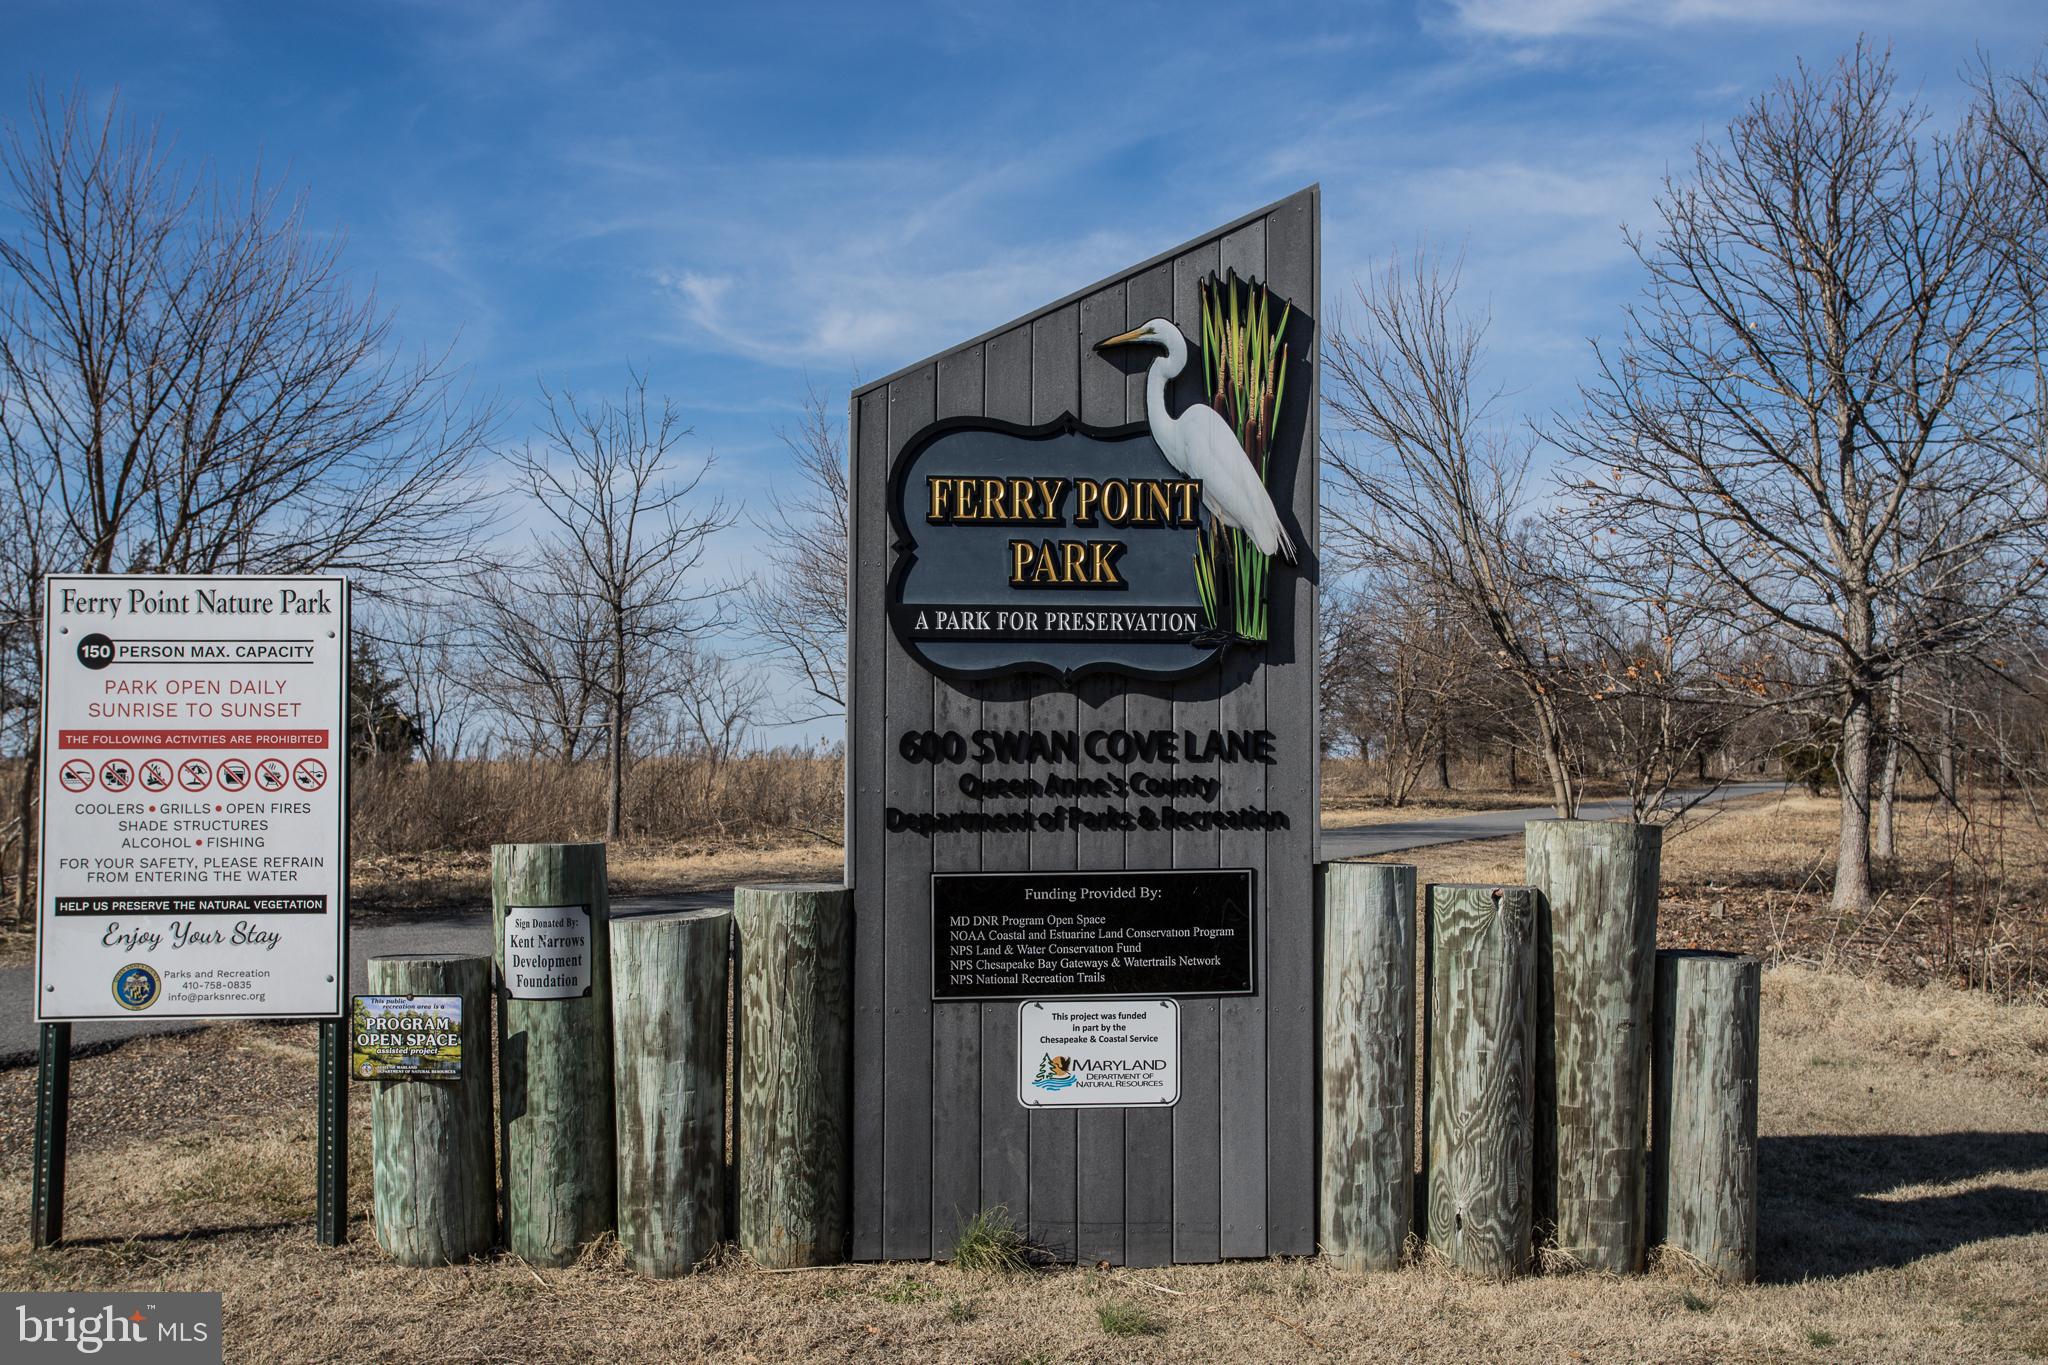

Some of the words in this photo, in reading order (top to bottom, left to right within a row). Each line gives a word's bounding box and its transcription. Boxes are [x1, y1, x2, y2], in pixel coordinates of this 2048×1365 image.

[927, 476, 1071, 527] FERRY
[1074, 479, 1202, 529] POINT
[1009, 539, 1128, 590] PARK
[60, 588, 122, 618] Ferry
[128, 588, 190, 614] Point
[195, 588, 273, 614] Nature
[279, 588, 332, 614] Park
[914, 611, 929, 630] A
[935, 611, 991, 631] PARK
[996, 611, 1038, 631] FOR
[1044, 612, 1197, 632] PRESERVATION
[81, 645, 111, 658] 150
[119, 646, 185, 658] PERSON
[191, 646, 230, 658] MAX.
[236, 646, 314, 658] CAPACITY
[105, 681, 157, 695] PARK
[165, 680, 221, 695] OPEN
[229, 680, 287, 695] DAILY
[88, 703, 179, 718] SUNRISE
[186, 703, 214, 718] TO
[221, 702, 302, 718] SUNSET
[66, 735, 88, 744] THE
[92, 735, 162, 744] FOLLOWING
[165, 735, 226, 744] ACTIVITIES
[229, 735, 252, 744] ARE
[256, 735, 322, 744] PROHIBITED
[900, 730, 968, 765] 600
[971, 730, 1079, 765] SWAN
[1084, 730, 1180, 765] COVE
[1184, 730, 1277, 765] LANE
[959, 772, 1043, 800] Queen
[1043, 772, 1129, 799] Anne's
[1129, 772, 1221, 803] County
[75, 804, 145, 815] COOLERS
[160, 803, 211, 815] GRILLS
[226, 803, 265, 814] OPEN
[270, 803, 311, 814] FIRES
[1038, 805, 1068, 831] of
[1068, 805, 1137, 831] Parks
[1137, 806, 1161, 831] &
[1161, 805, 1290, 831] Recreation
[118, 821, 168, 832] SHADE
[173, 820, 269, 832] STRUCTURES
[122, 838, 192, 849] ALCOHOL
[207, 838, 265, 848] FISHING
[60, 858, 89, 869] FOR
[94, 858, 134, 869] YOUR
[140, 858, 199, 869] SAFETY,
[204, 857, 257, 868] PLEASE
[263, 857, 324, 868] REFRAIN
[87, 872, 129, 883] FROM
[135, 871, 209, 882] ENTERING
[214, 871, 243, 882] THE
[247, 870, 298, 882] WATER
[1024, 888, 1077, 902] Funding
[1080, 887, 1137, 900] Provided
[1140, 887, 1162, 900] By:
[60, 902, 90, 911] HELP
[93, 902, 109, 911] US
[112, 901, 170, 911] PRESERVE
[173, 901, 196, 910] THE
[199, 900, 251, 910] NATURAL
[254, 899, 323, 910] VEGETATION
[515, 919, 530, 929] Sign
[533, 918, 563, 928] Donated
[567, 918, 578, 929] By:
[950, 916, 970, 926] MD
[973, 916, 999, 926] DNR
[1002, 916, 1044, 928] Program
[1047, 915, 1074, 927] Open
[1077, 915, 1106, 926] Space
[101, 922, 163, 951] Enjoy
[169, 922, 225, 949] Your
[231, 921, 282, 950] Stay
[950, 931, 986, 941] NOAA
[989, 930, 1026, 940] Coastal
[1029, 930, 1047, 939] and
[1050, 929, 1096, 939] Estuarine
[1099, 928, 1123, 938] Land
[1126, 928, 1190, 938] Conservation
[1193, 927, 1234, 939] Program
[510, 935, 534, 948] Kent
[538, 935, 584, 948] Narrows
[950, 946, 973, 955] NPS
[976, 945, 1001, 955] Land
[1004, 945, 1014, 955] &
[1017, 944, 1046, 955] Water
[1049, 943, 1113, 954] Conservation
[1116, 942, 1142, 952] Fund
[513, 954, 582, 971] Development
[950, 960, 973, 970] NPS
[976, 959, 1035, 972] Chesapeake
[1038, 959, 1057, 971] Bay
[1061, 958, 1108, 970] Gateways
[1111, 957, 1121, 967] &
[1124, 956, 1176, 967] Watertrails
[1179, 955, 1221, 966] Network
[164, 969, 193, 979] Parks
[196, 969, 214, 978] and
[217, 969, 270, 978] Recreation
[950, 975, 973, 985] NPS
[976, 974, 1018, 984] National
[1022, 973, 1074, 983] Recreation
[1077, 972, 1105, 983] Trails
[182, 981, 252, 990] 410-758-0835
[516, 974, 578, 988] Foundation
[168, 992, 266, 1002] info@parksnrec.org
[1071, 1013, 1099, 1021] project
[366, 1018, 450, 1030] PROGRAM
[1082, 1024, 1099, 1032] part
[1101, 1024, 1111, 1032] by
[357, 1033, 402, 1046] OPEN
[406, 1033, 458, 1046] SPACE
[1040, 1036, 1088, 1044] Chesapeake
[1099, 1035, 1128, 1043] Coastal
[1072, 1059, 1166, 1071] MARYLAND
